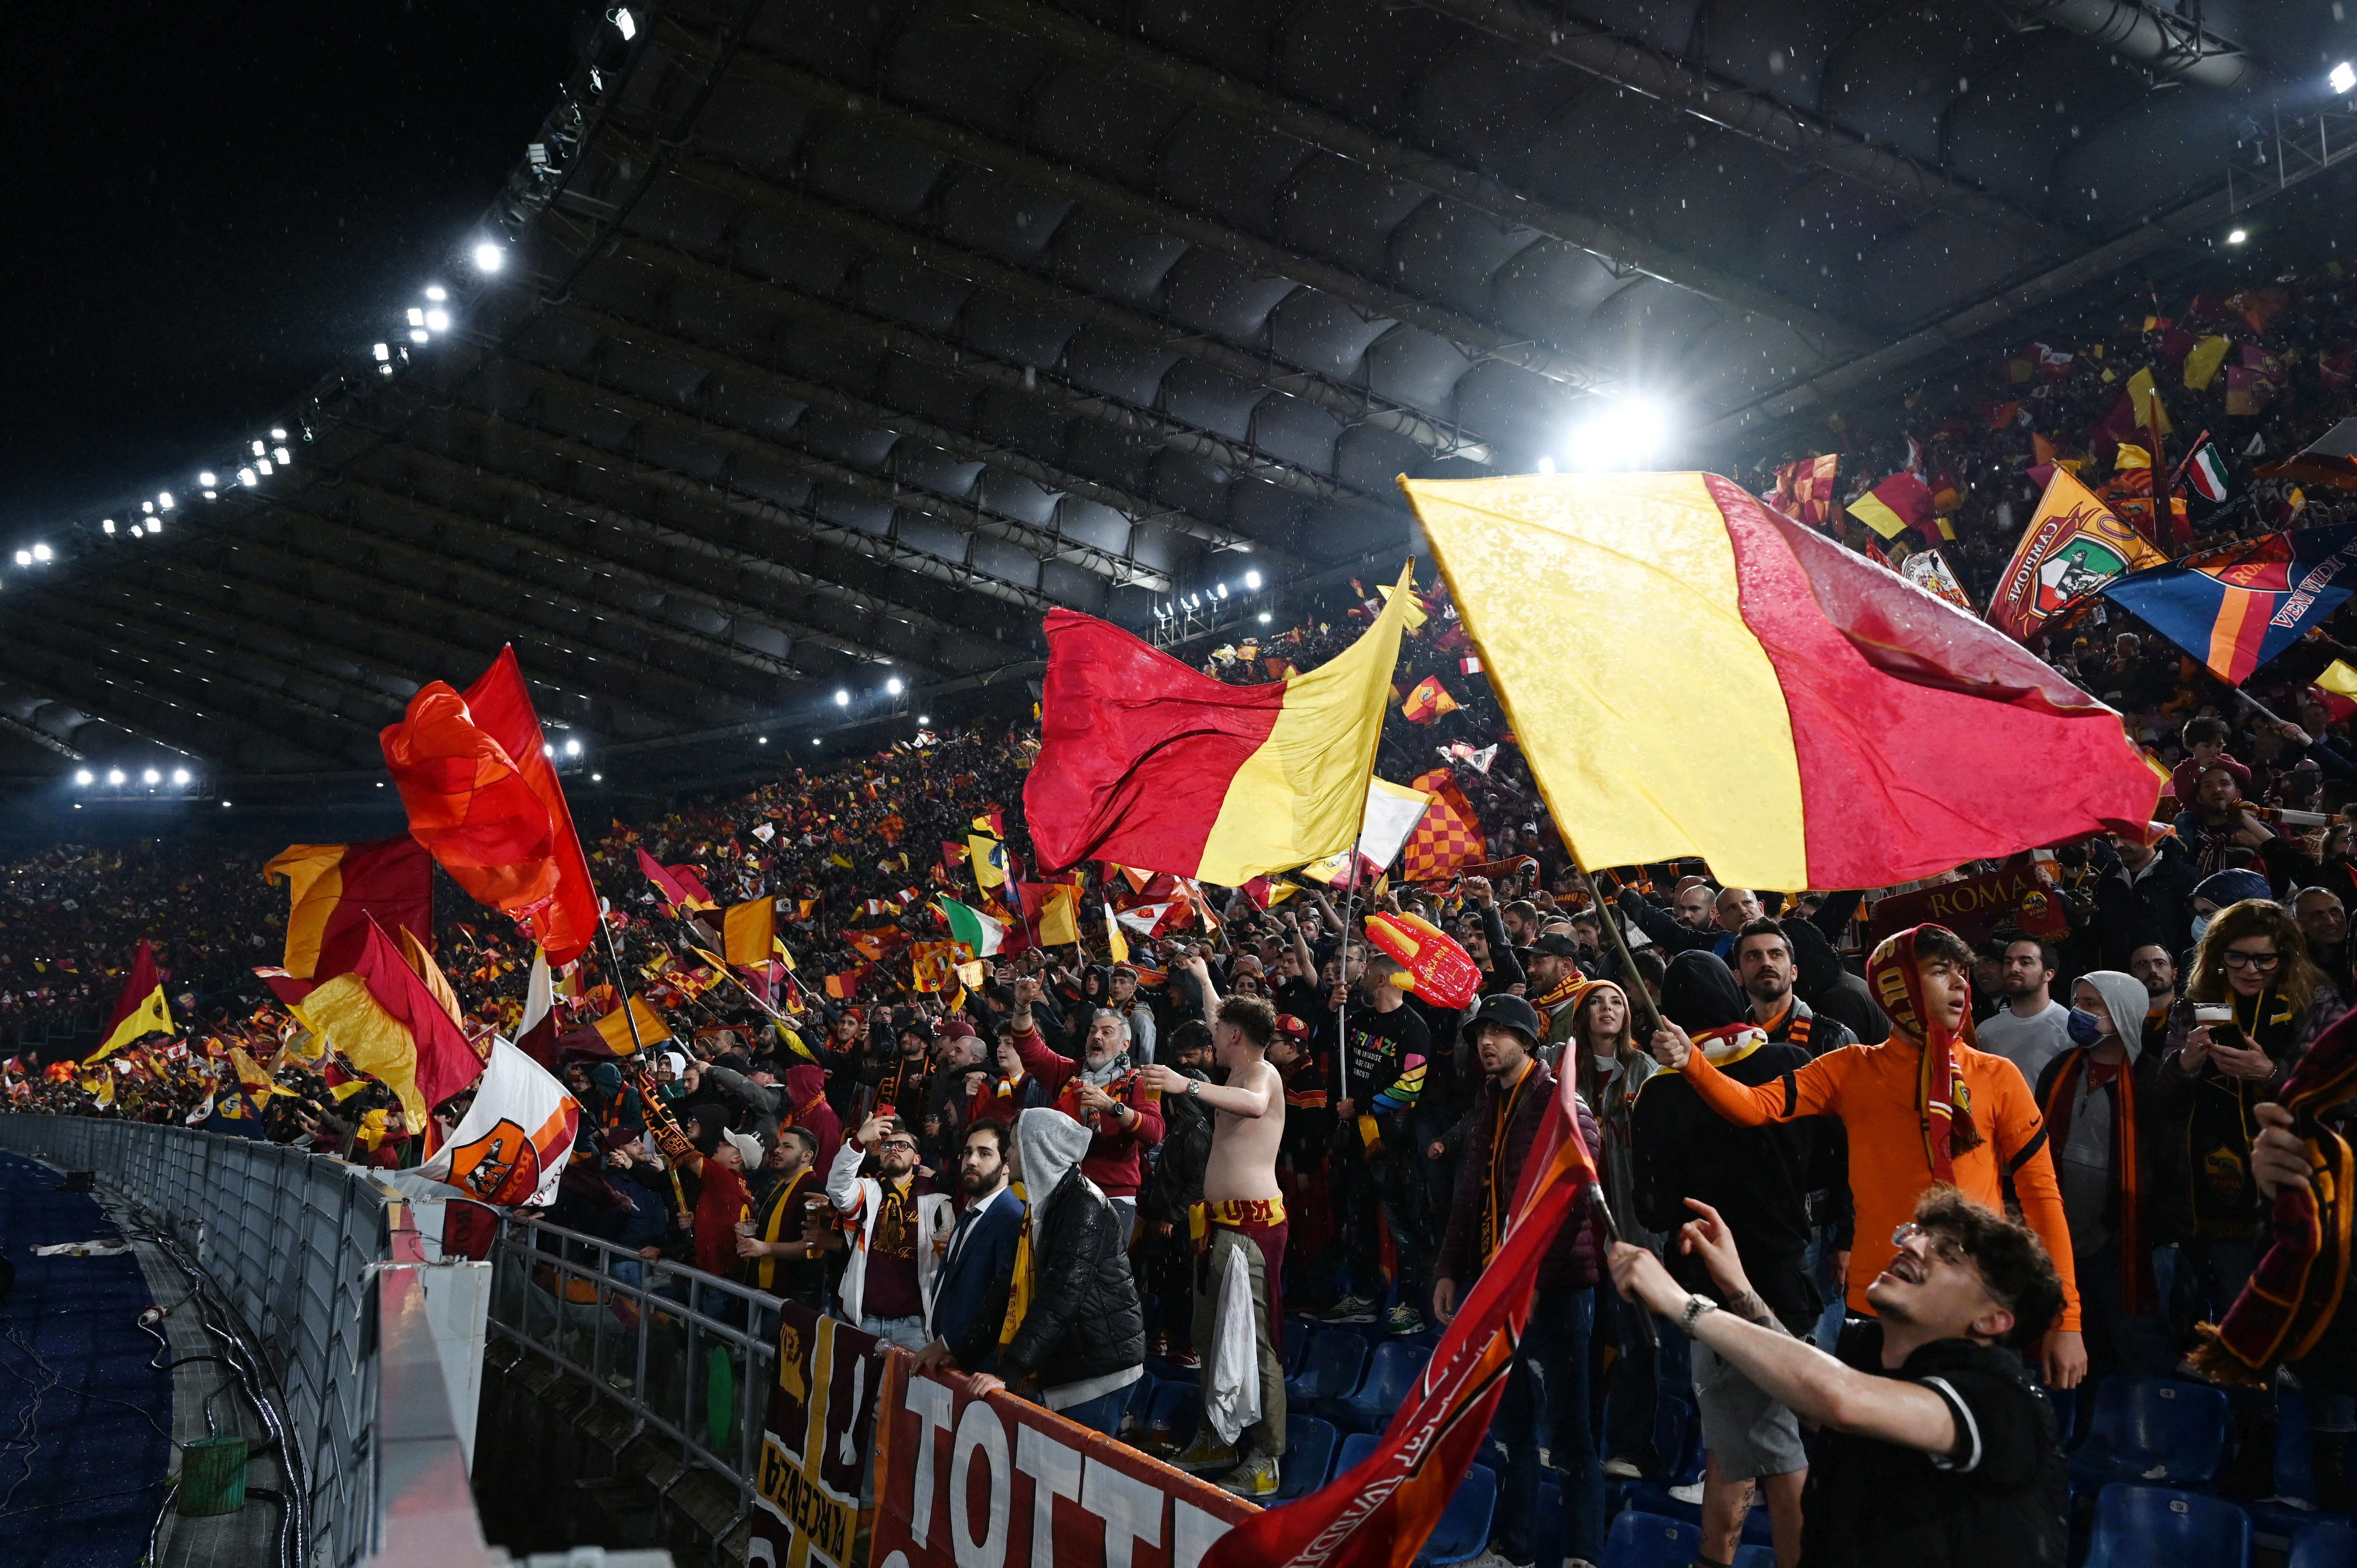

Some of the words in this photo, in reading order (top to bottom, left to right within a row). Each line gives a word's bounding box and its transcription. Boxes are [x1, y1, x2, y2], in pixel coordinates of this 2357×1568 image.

[2269, 589, 2315, 628] VENI
[2299, 555, 2346, 594] VIDI
[1486, 860, 1511, 873] ROMA
[1930, 874, 2028, 918] ROMA
[2028, 907, 2048, 916] ROMA
[807, 1014, 823, 1026] ROMA
[905, 1369, 1236, 1568] TOTT
[764, 1446, 847, 1562] PIACENZA
